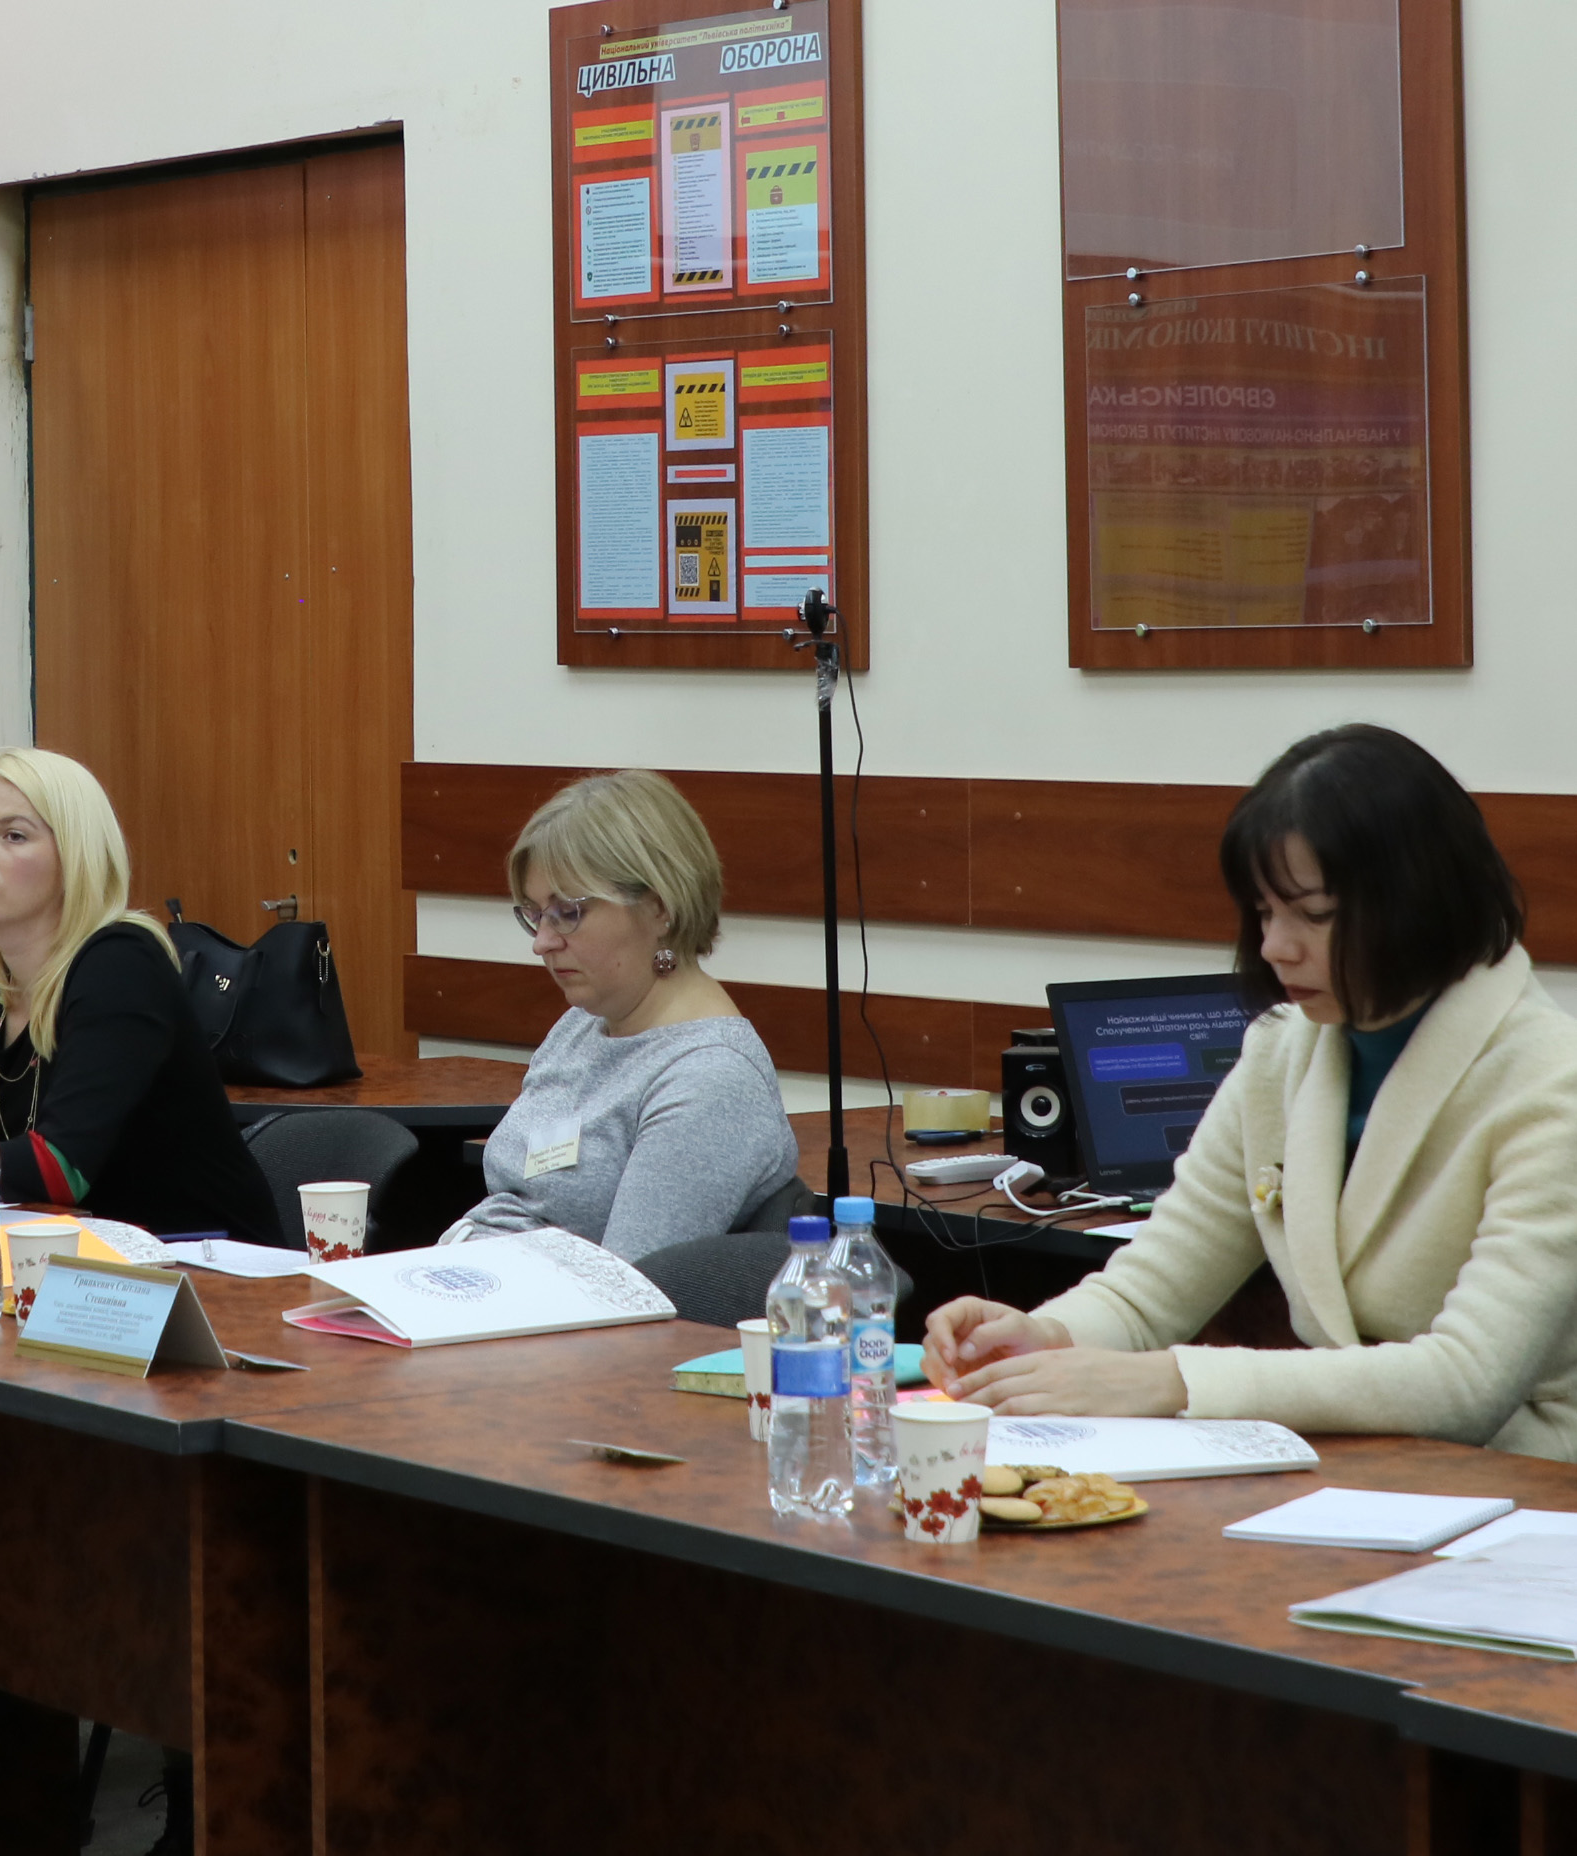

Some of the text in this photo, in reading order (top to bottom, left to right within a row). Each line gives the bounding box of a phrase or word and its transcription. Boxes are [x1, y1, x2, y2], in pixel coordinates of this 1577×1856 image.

[721, 34, 821, 71] ОБОРОНА
[578, 55, 674, 96] ЦИВІЛЬНА
[1107, 1013, 1167, 1025] Найважливіші
[1095, 1026, 1151, 1037] Сполученим
[1152, 1023, 1188, 1032] Штатам
[1188, 1023, 1210, 1032] роль
[1211, 1019, 1241, 1029] лідера
[115, 1281, 151, 1296] Світлана
[84, 1291, 127, 1308] Степанівна
[859, 1348, 888, 1360] aqua
